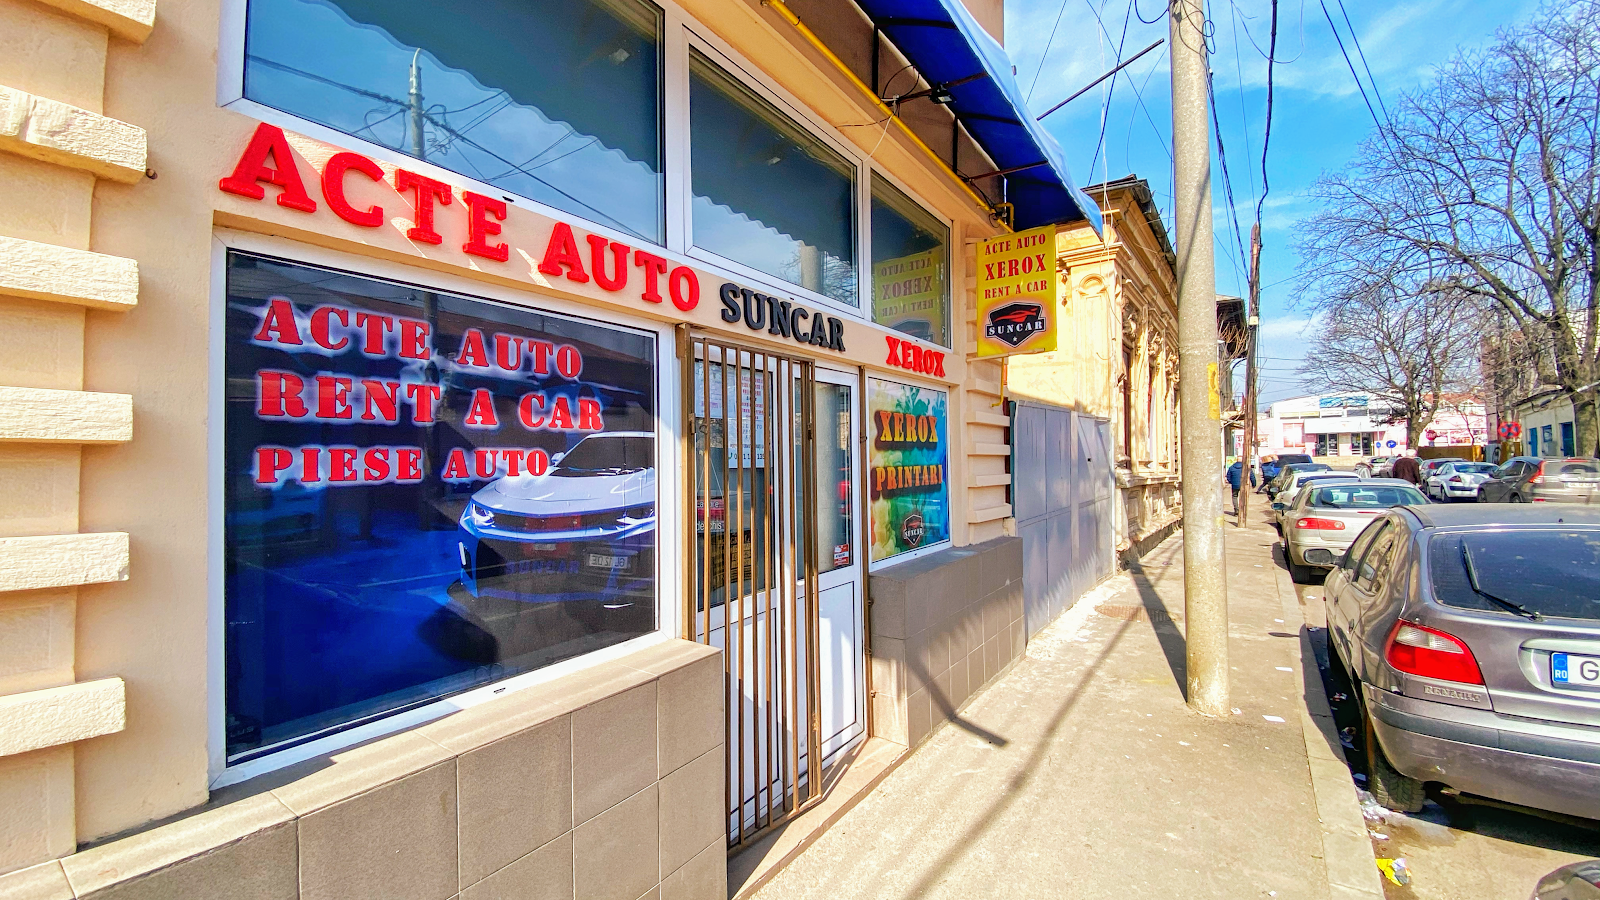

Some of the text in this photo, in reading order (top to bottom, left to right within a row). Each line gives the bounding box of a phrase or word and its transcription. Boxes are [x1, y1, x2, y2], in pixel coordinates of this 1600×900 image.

[219, 122, 700, 311] ACTE AUTO
[985, 233, 1046, 255] ACTE AUTO
[985, 253, 1046, 281] XEROX
[984, 280, 1047, 299] RENT A CAR
[719, 282, 846, 351] SUNCAR
[988, 320, 1043, 336] SUNCAR
[254, 299, 582, 378] ACTE AUTO
[885, 335, 946, 378] XEROX
[258, 371, 603, 430] RENT A CAR
[880, 410, 938, 443] XEROX
[256, 447, 548, 483] PIESE AUTO
[876, 464, 942, 491] PRINTARI
[1554, 669, 1568, 679] RO
[1424, 685, 1481, 703] RENAULT
